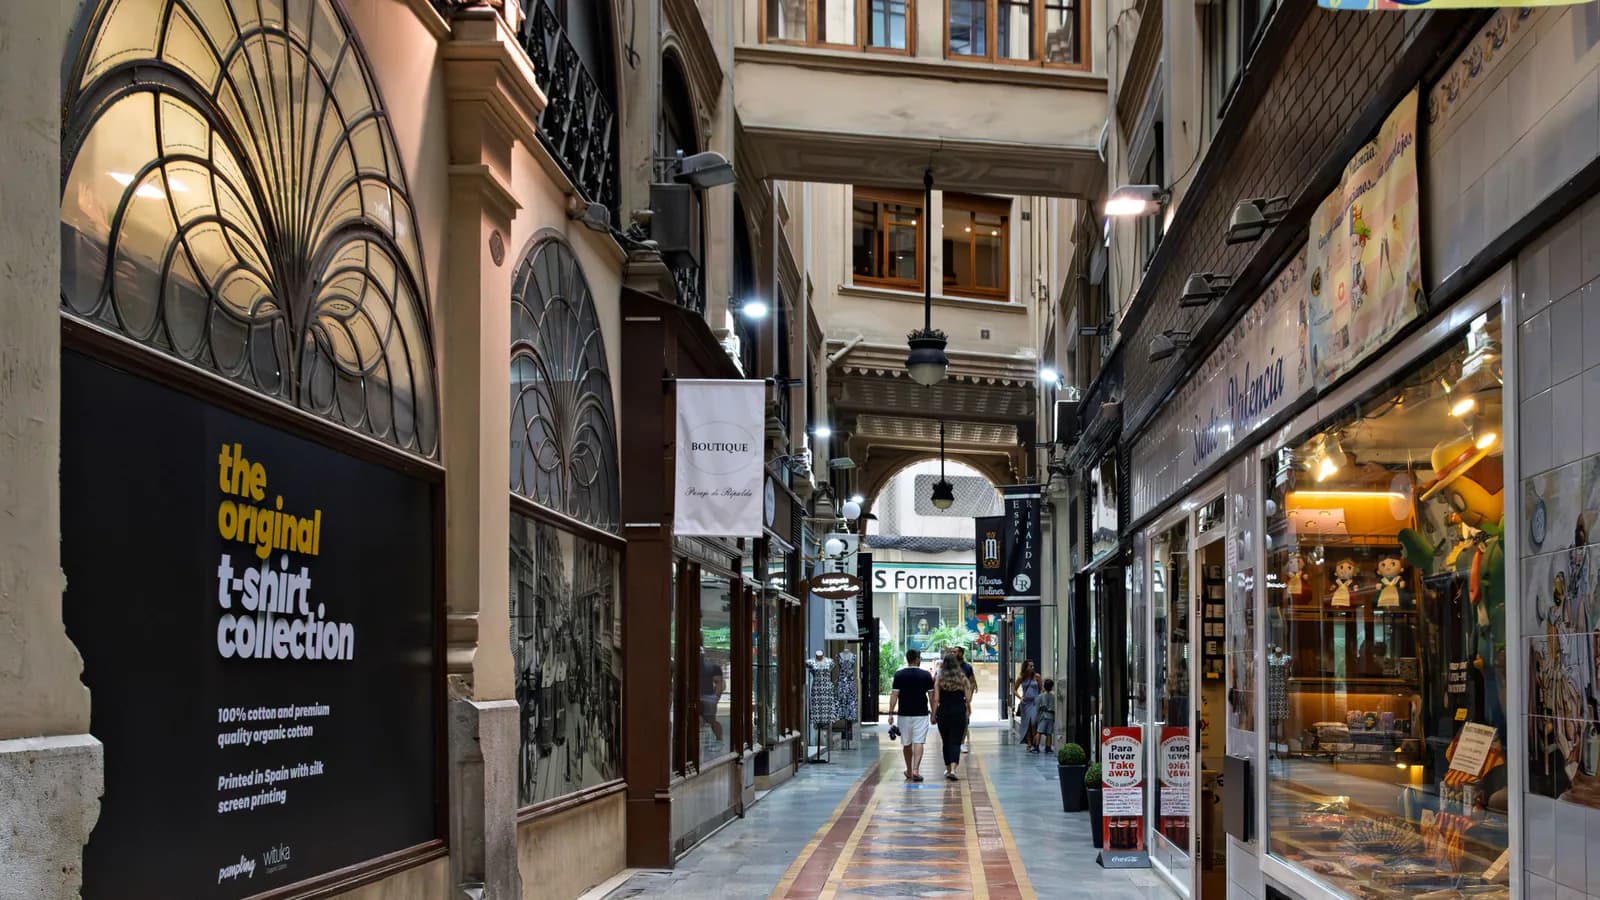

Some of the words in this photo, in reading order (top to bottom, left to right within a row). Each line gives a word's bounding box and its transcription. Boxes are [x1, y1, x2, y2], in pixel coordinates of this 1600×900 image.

[1228, 346, 1285, 436] Valencia
[691, 442, 749, 453] BOUTIQUE
[218, 442, 267, 501] the
[218, 495, 322, 560] original
[1025, 500, 1033, 569] RIPALDA
[217, 553, 312, 616] t-shirt
[874, 570, 887, 589] S
[895, 570, 974, 591] Formaci
[217, 602, 355, 660] collection
[218, 707, 246, 723] 100%
[247, 708, 277, 721] cotton
[277, 704, 294, 718] and
[294, 702, 330, 720] premium
[218, 727, 252, 749] quality
[253, 724, 286, 745] organic
[287, 725, 313, 739] cotton
[1111, 744, 1133, 753] Para
[218, 771, 253, 791] Printed
[254, 768, 264, 783] in
[264, 765, 289, 785] Spain
[290, 763, 309, 779] with
[309, 760, 324, 775] silk
[1108, 770, 1136, 779] away
[1109, 761, 1135, 770] Take
[218, 797, 250, 814] screen
[250, 787, 287, 810] printing
[218, 855, 256, 884] pampling
